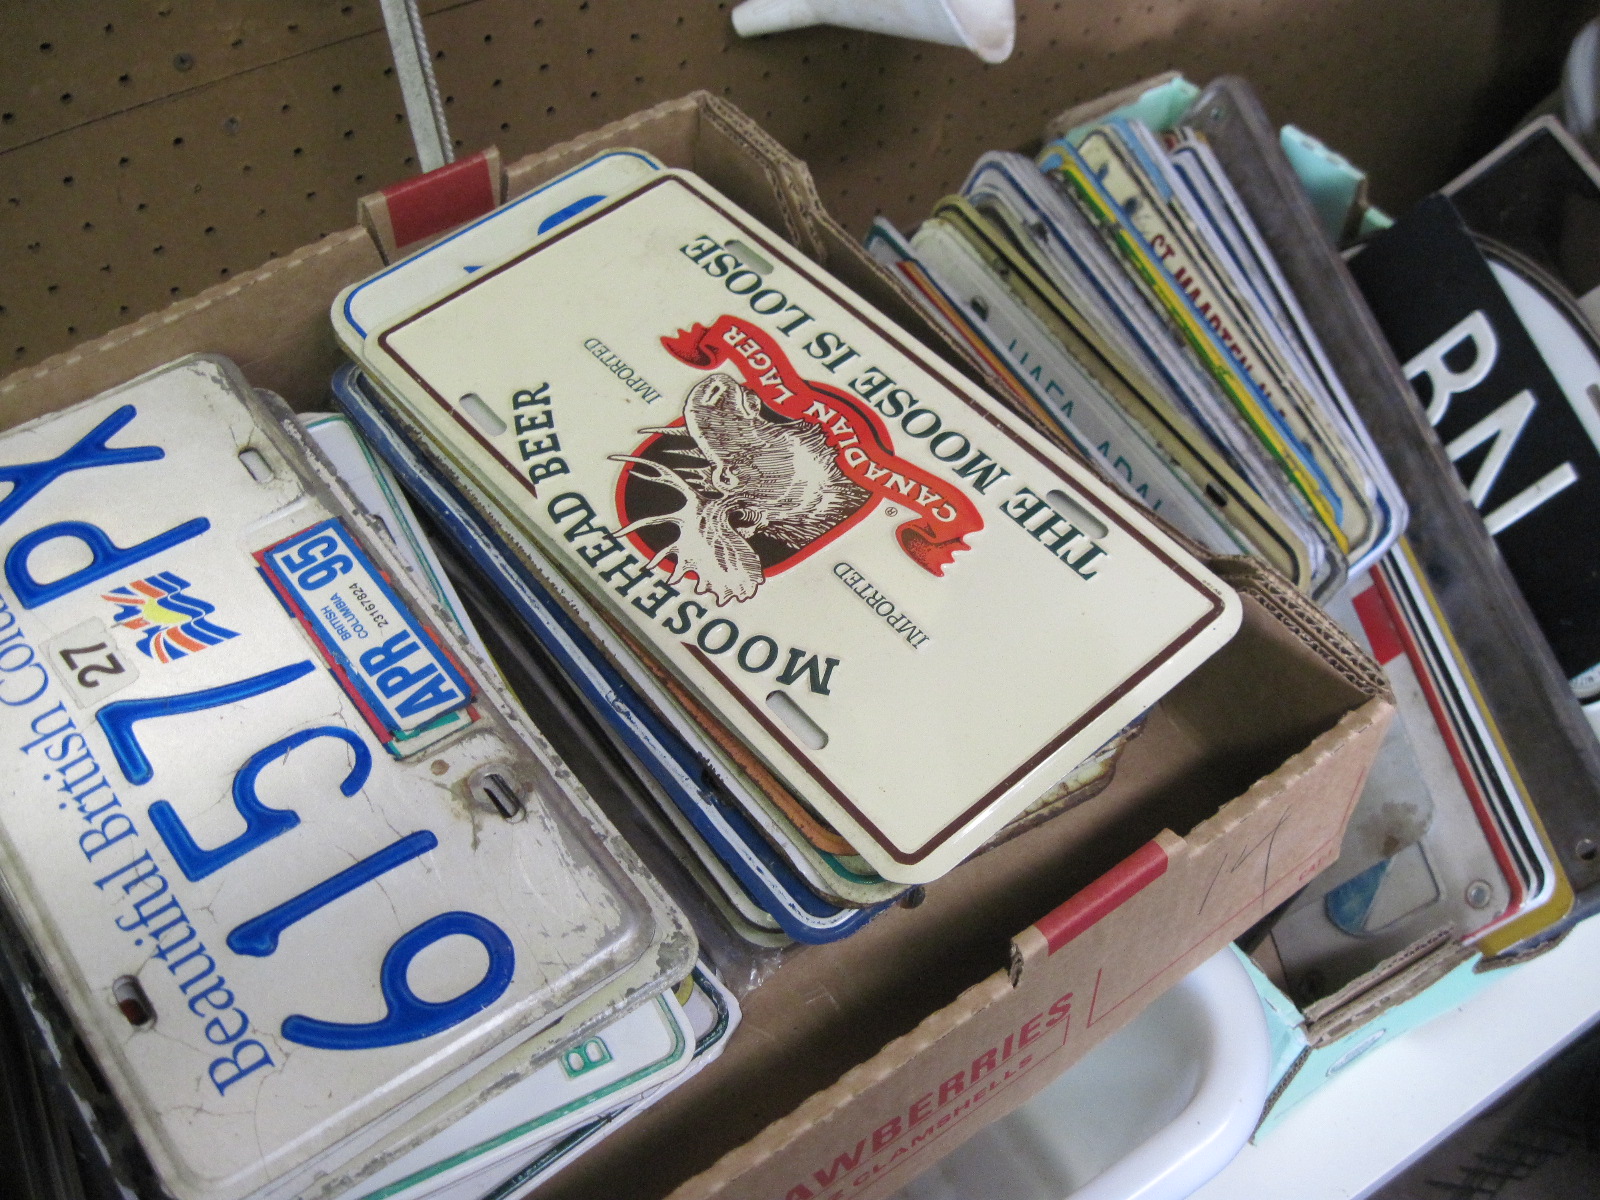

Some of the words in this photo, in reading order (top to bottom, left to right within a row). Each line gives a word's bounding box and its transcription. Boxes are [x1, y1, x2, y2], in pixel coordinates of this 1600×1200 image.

[679, 234, 816, 338] LOOSE
[584, 338, 663, 405] IMPORTED
[722, 325, 798, 405] LAGER
[802, 332, 861, 374] IS
[512, 381, 571, 485] BEER
[803, 400, 958, 523] CANADIAN
[848, 366, 1011, 496] MOOSE
[280, 535, 354, 592] 95
[999, 487, 1109, 581] THE
[320, 606, 353, 642] BRITISH
[330, 592, 370, 640] COLUMBIA
[348, 582, 389, 628] 23167824
[547, 491, 840, 696] MOOSEHEAD
[832, 561, 930, 650] IMPORTED
[59, 641, 126, 689] 27
[359, 629, 460, 719] APR
[19, 700, 139, 863] British
[95, 659, 515, 1051] 6157
[93, 848, 276, 1097] Beautiful
[852, 1054, 1034, 1187] CLAMSHELLS
